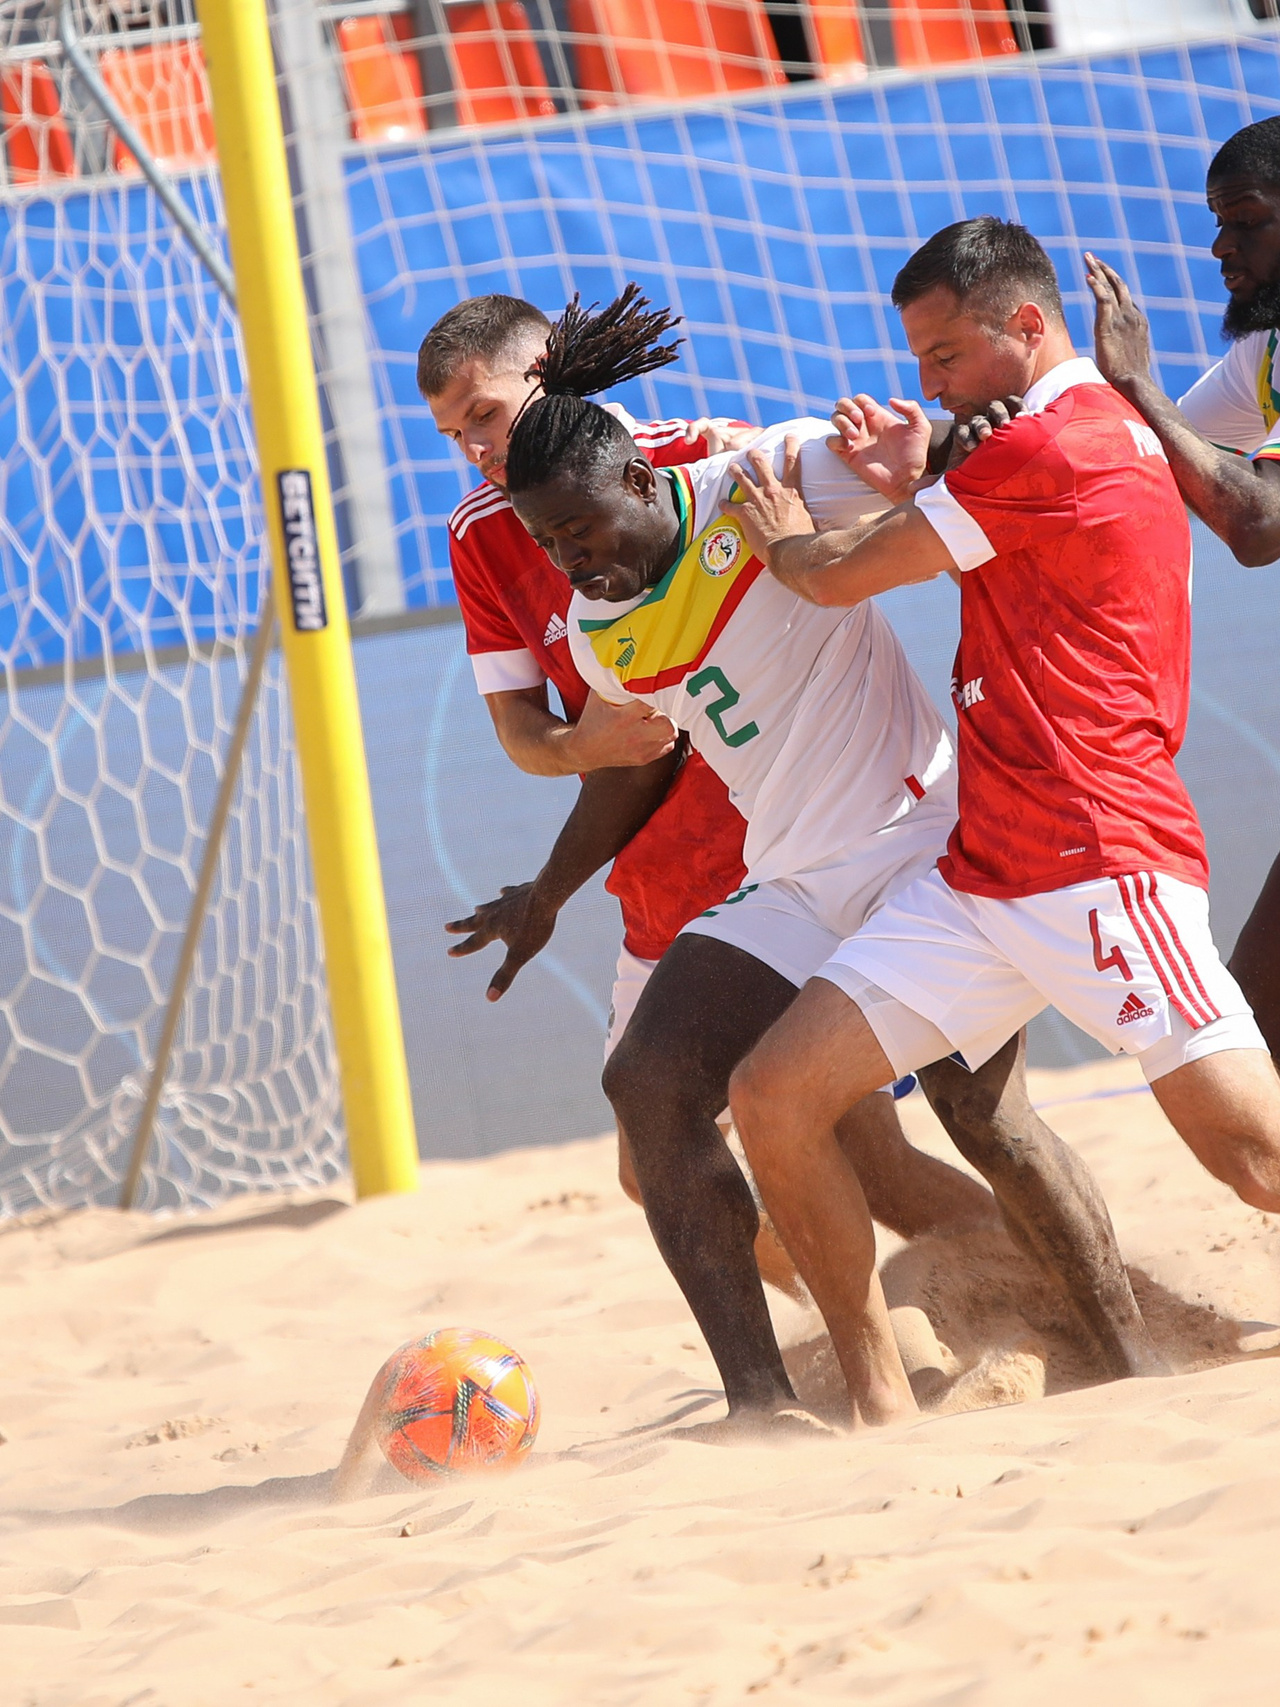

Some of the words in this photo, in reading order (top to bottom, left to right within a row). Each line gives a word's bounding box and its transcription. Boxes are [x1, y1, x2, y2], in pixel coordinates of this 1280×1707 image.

[543, 628, 568, 647] adida
[685, 665, 760, 749] 2
[1088, 907, 1134, 982] 4
[1116, 1006, 1155, 1026] adidas
